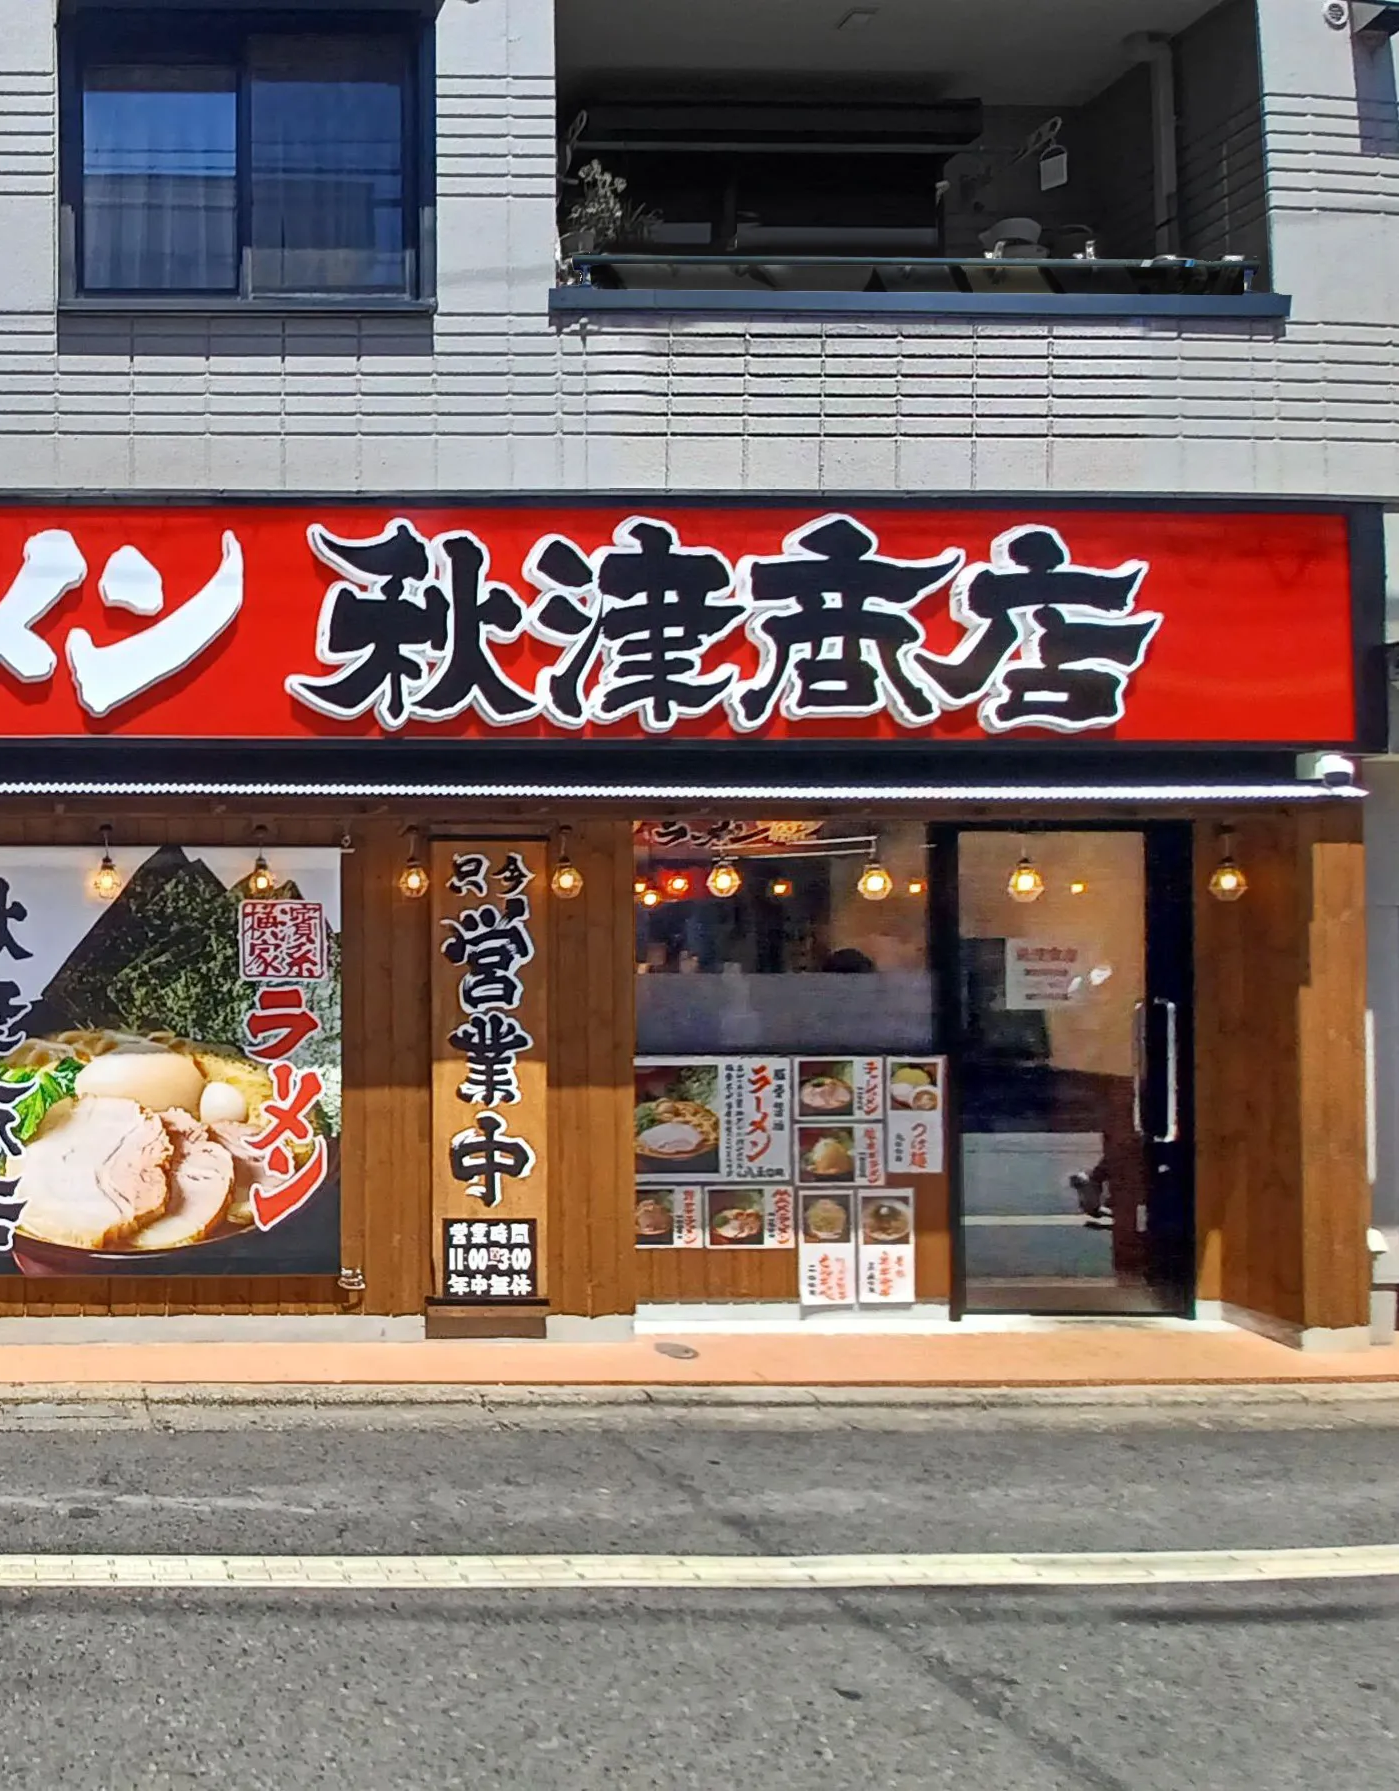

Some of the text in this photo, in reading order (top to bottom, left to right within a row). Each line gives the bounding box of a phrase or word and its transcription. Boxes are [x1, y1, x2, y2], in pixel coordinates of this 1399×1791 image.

[285, 512, 1164, 734] 秋津商店
[445, 852, 537, 898] 只今
[441, 894, 536, 1208] 営業中
[241, 985, 328, 1231] ラーメン
[745, 1064, 773, 1163] ラーメン
[909, 1122, 927, 1169] つけ麺
[449, 1222, 529, 1245] 営業時間
[447, 1273, 532, 1296] 年中無休
